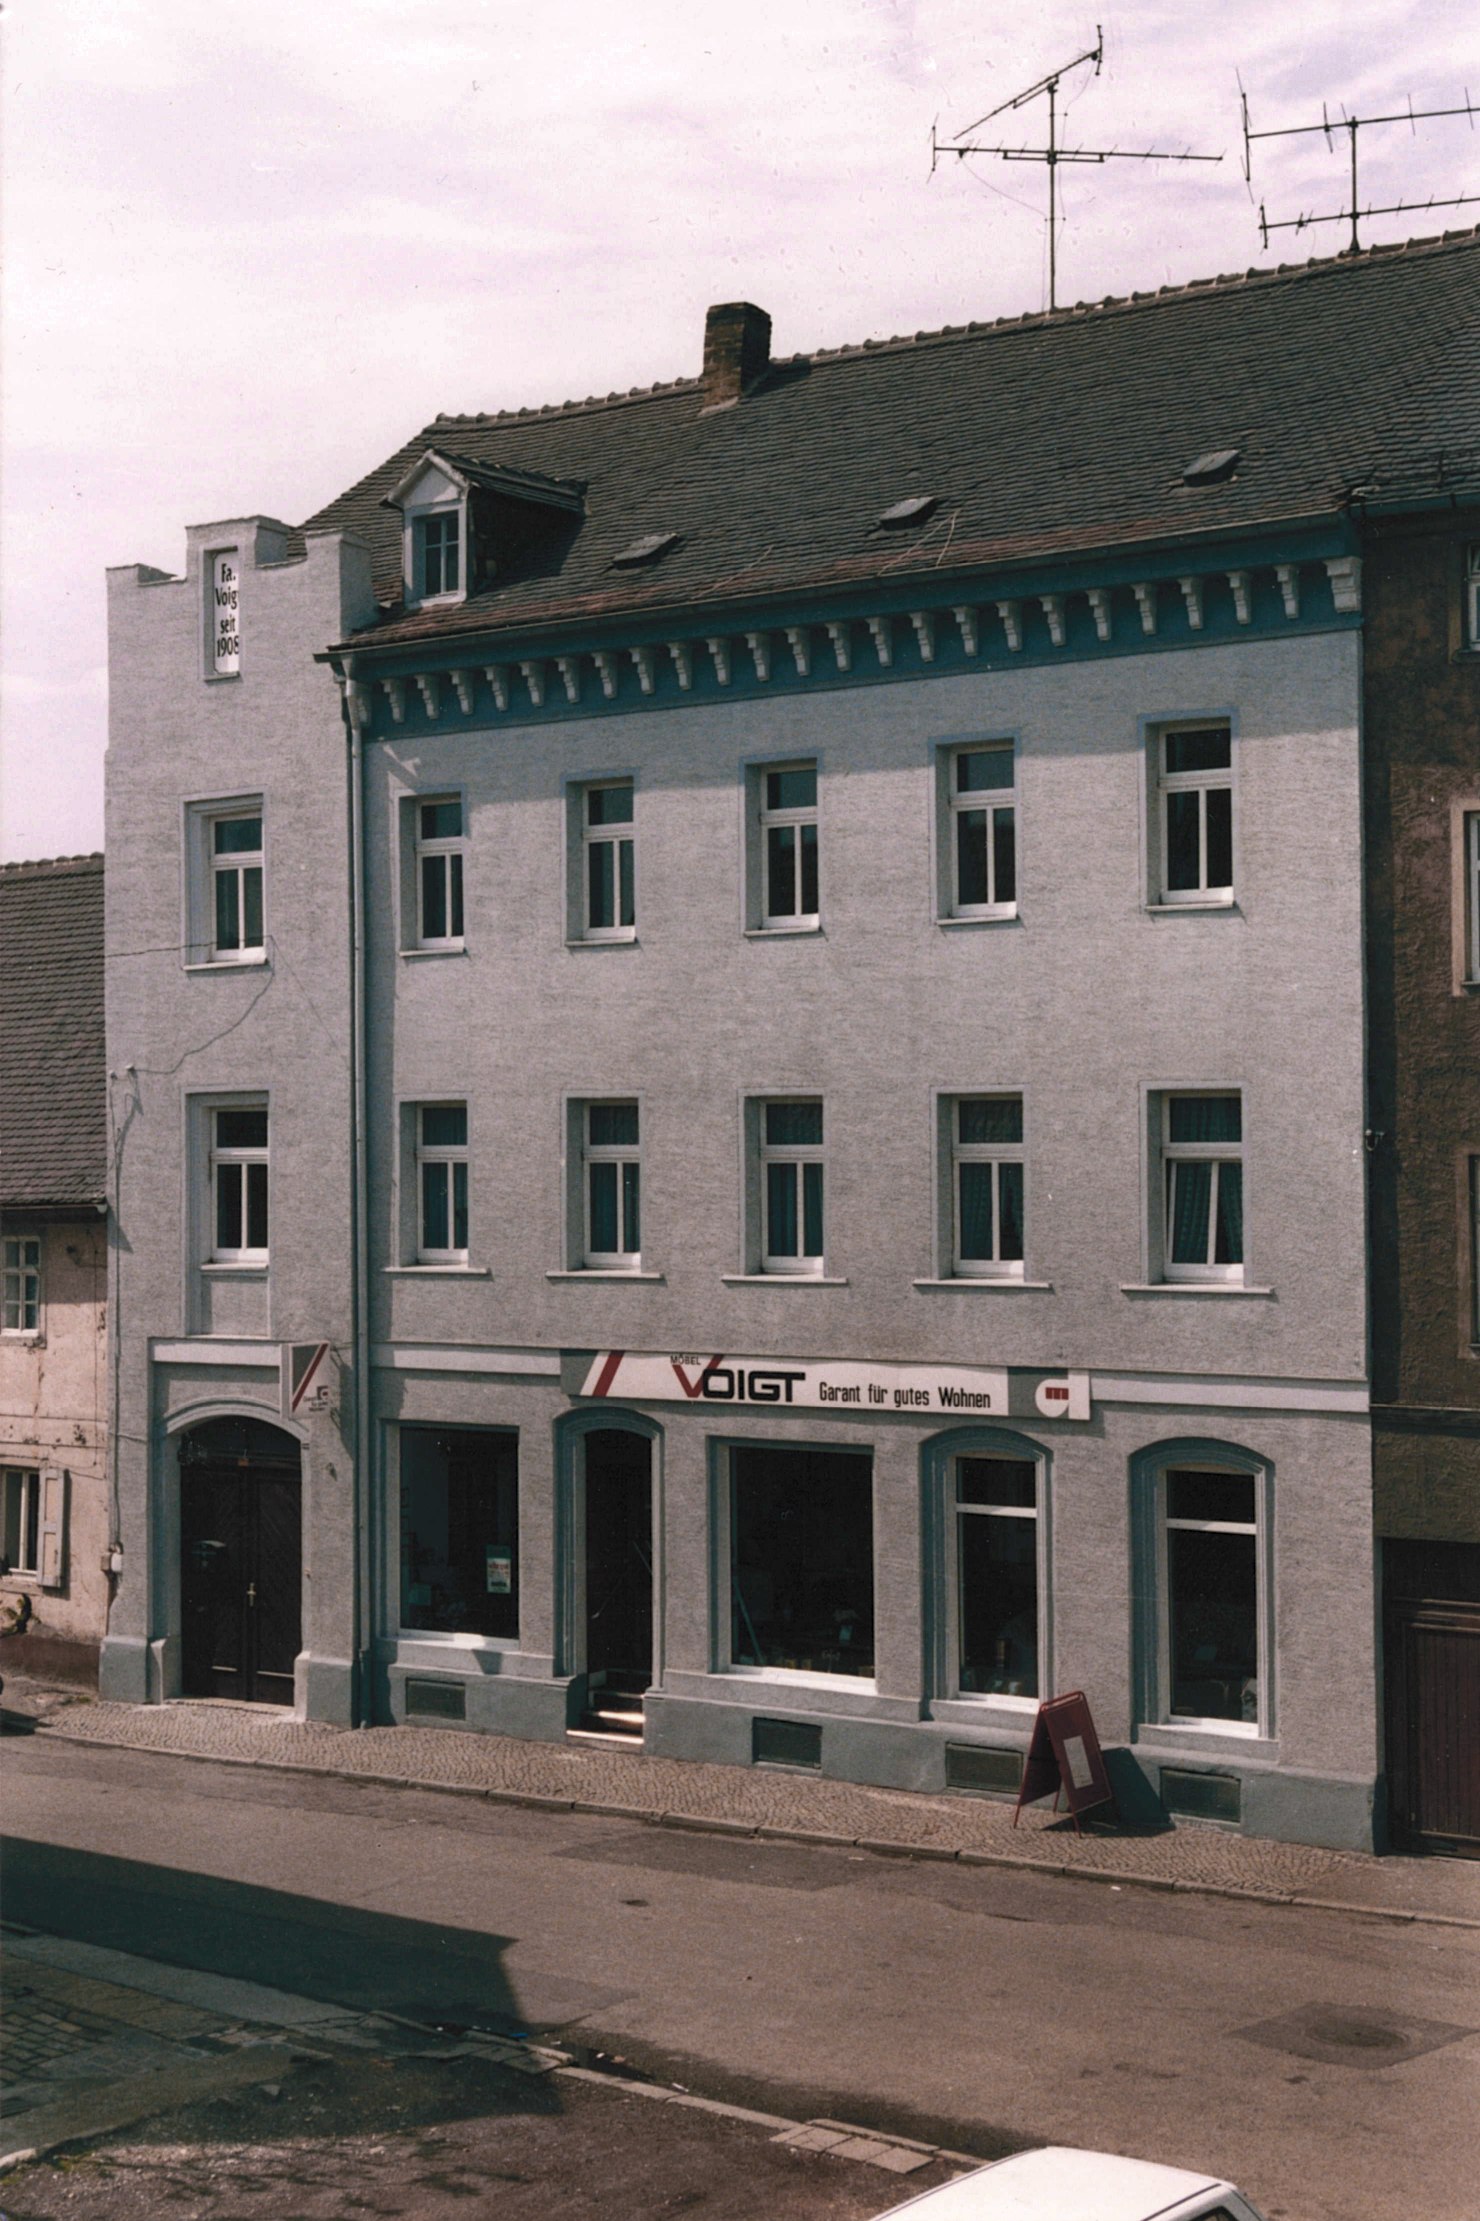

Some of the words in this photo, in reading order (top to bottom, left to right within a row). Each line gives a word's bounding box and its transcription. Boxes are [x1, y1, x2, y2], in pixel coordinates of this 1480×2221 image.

[221, 563, 236, 583] Fa.
[215, 586, 238, 610] Voig
[220, 614, 236, 634] seit
[670, 1355, 701, 1366] MÖBEL
[672, 1354, 806, 1402] VOIGT
[819, 1381, 861, 1403] Garant
[868, 1383, 888, 1404] für
[894, 1388, 930, 1408] gutes
[938, 1386, 991, 1408] Wohnen
